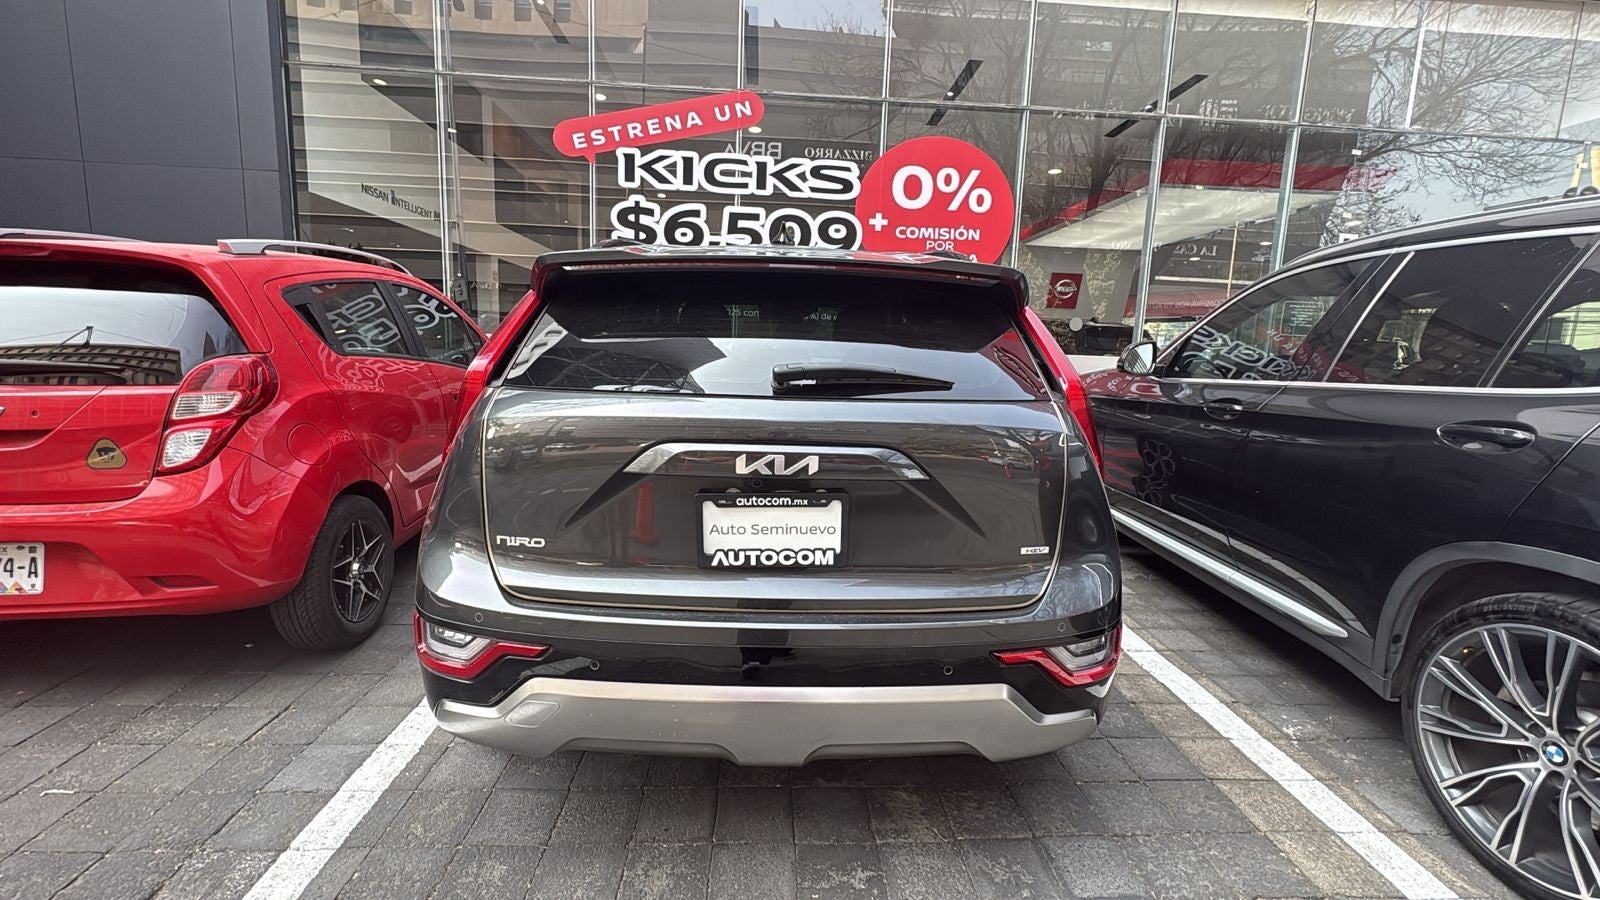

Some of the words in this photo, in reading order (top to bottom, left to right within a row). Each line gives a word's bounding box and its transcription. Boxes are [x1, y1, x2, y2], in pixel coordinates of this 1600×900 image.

[572, 111, 703, 149] ESTRENA
[713, 100, 753, 122] UN
[618, 150, 859, 199] KICKS
[361, 182, 389, 203] NISSAN
[891, 165, 993, 214] 0%
[612, 197, 860, 250] $6509
[895, 225, 981, 241] COMISIÓN
[926, 240, 954, 251] POR
[735, 453, 819, 476] KIA
[736, 496, 808, 506] autocom.mx
[709, 524, 746, 535] Auto
[750, 523, 837, 535] Seminuevo
[496, 535, 546, 548] NIRO
[711, 549, 834, 566] AUTOCOM
